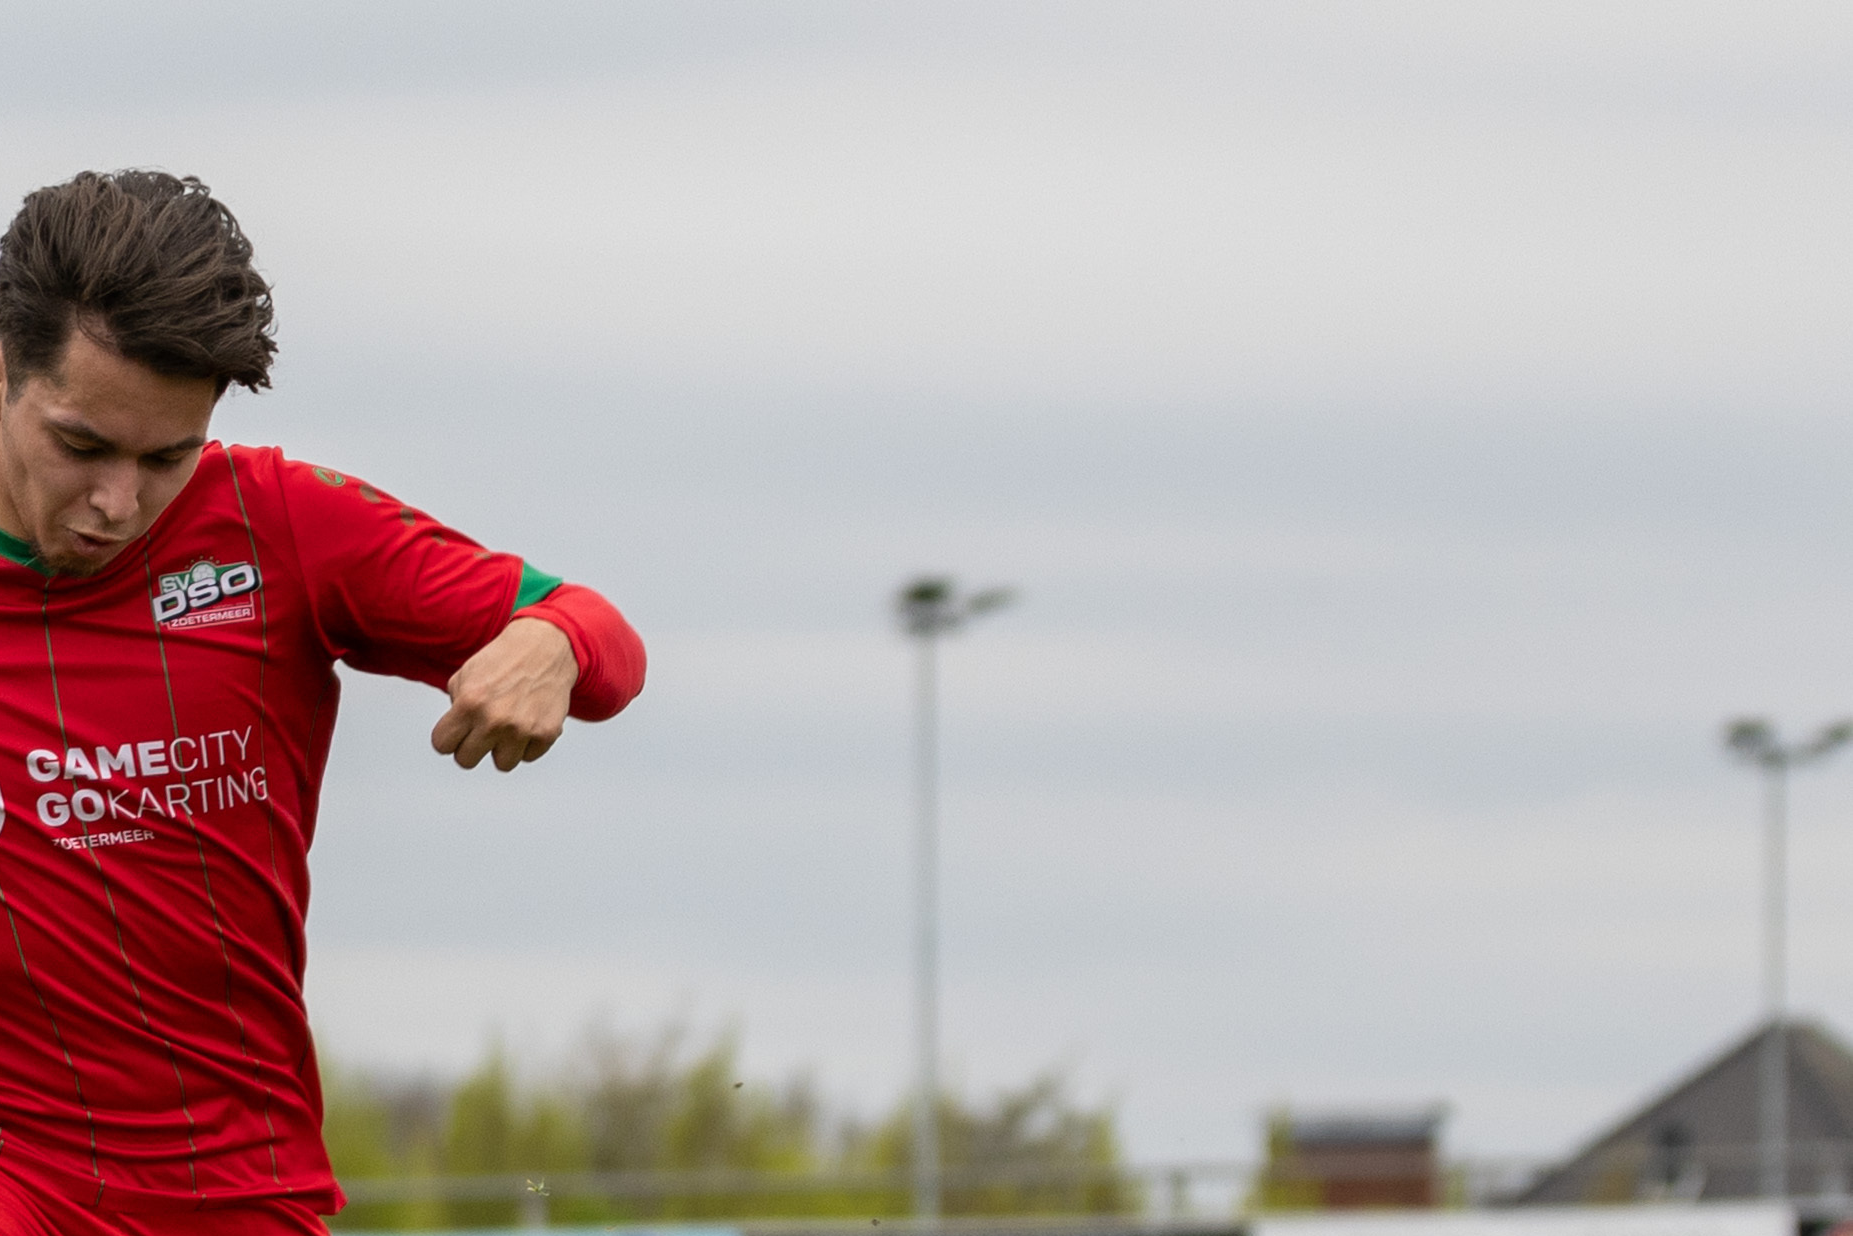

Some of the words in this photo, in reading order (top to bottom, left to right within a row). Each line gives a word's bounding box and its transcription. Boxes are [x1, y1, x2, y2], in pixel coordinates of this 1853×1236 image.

[152, 564, 256, 622] DSO
[161, 573, 190, 593] SV
[170, 607, 251, 628] ZOETERMEER
[26, 725, 252, 782] GAMECITY
[36, 766, 268, 827] GOKARTING
